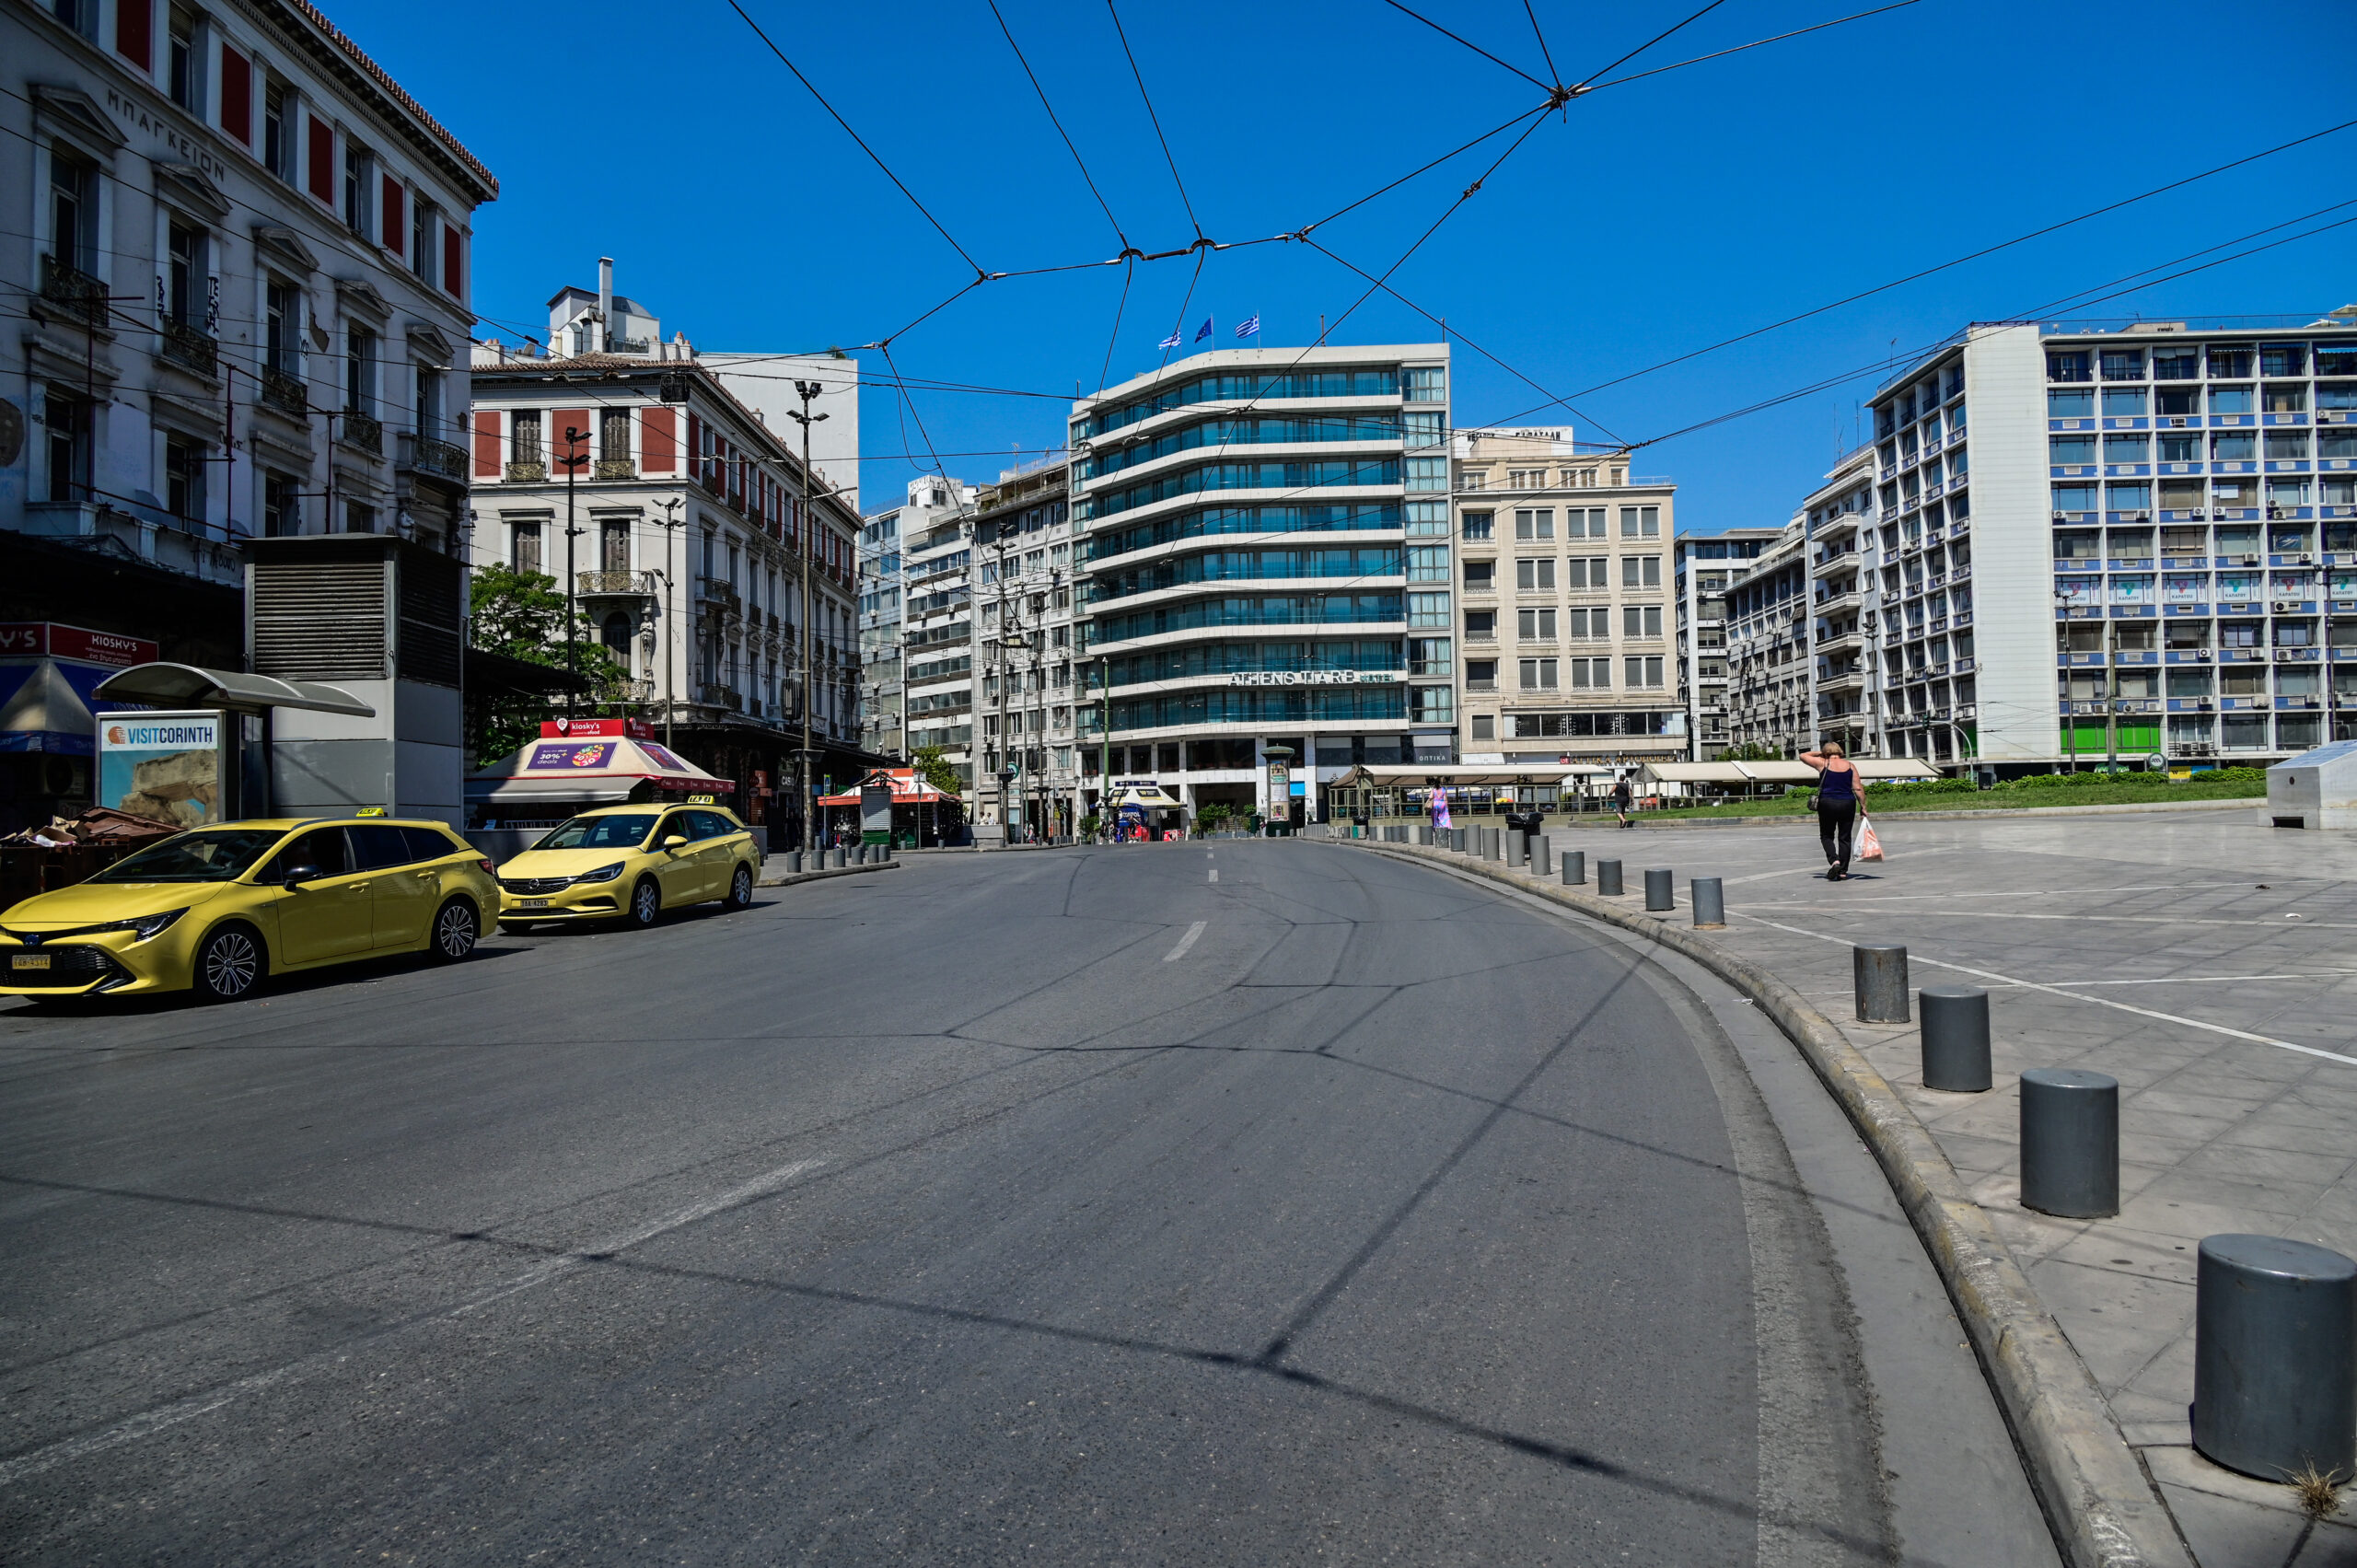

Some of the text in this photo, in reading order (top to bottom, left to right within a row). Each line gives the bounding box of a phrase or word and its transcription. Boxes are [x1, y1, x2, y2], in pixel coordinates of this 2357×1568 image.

[108, 88, 224, 182] ΜΠΑΓΚΕΙΟΝ
[91, 634, 137, 652] KIOSKY'S
[1228, 669, 1397, 686] ATHENS TIARE HOTEL
[128, 726, 213, 744] VISITCORINTH
[572, 722, 600, 730] kiosky's
